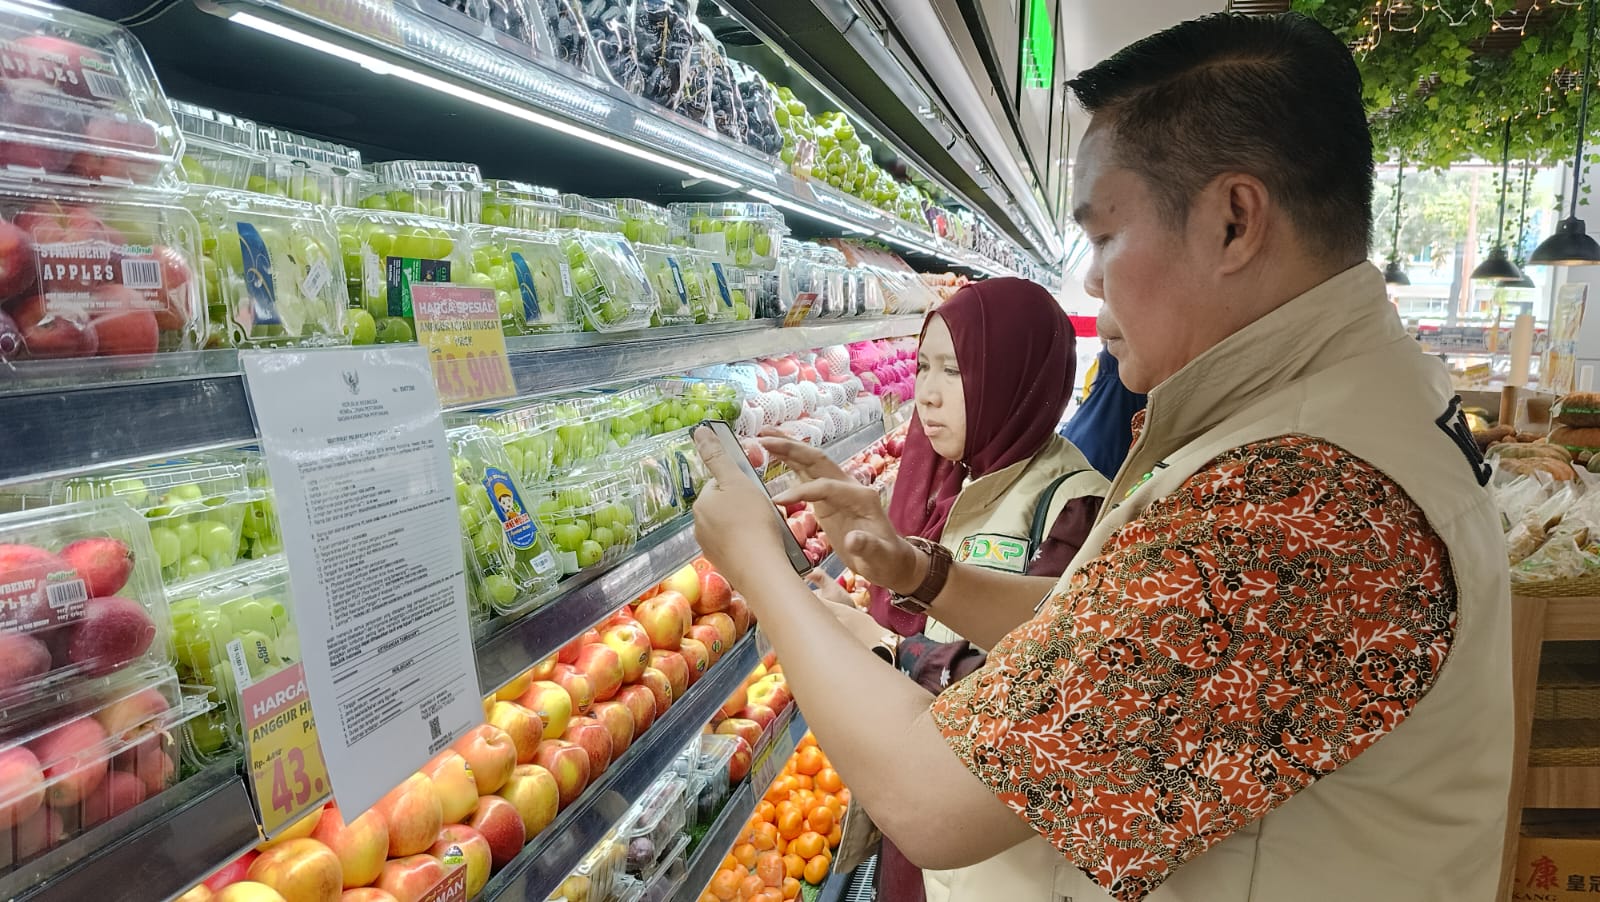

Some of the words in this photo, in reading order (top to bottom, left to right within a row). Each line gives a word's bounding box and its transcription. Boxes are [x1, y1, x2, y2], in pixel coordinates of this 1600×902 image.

[43, 264, 114, 280] APPLES
[473, 320, 498, 331] MUSCAT
[972, 538, 1025, 561] DKP
[252, 679, 308, 720] HARGA
[252, 707, 298, 744] ANGGUR
